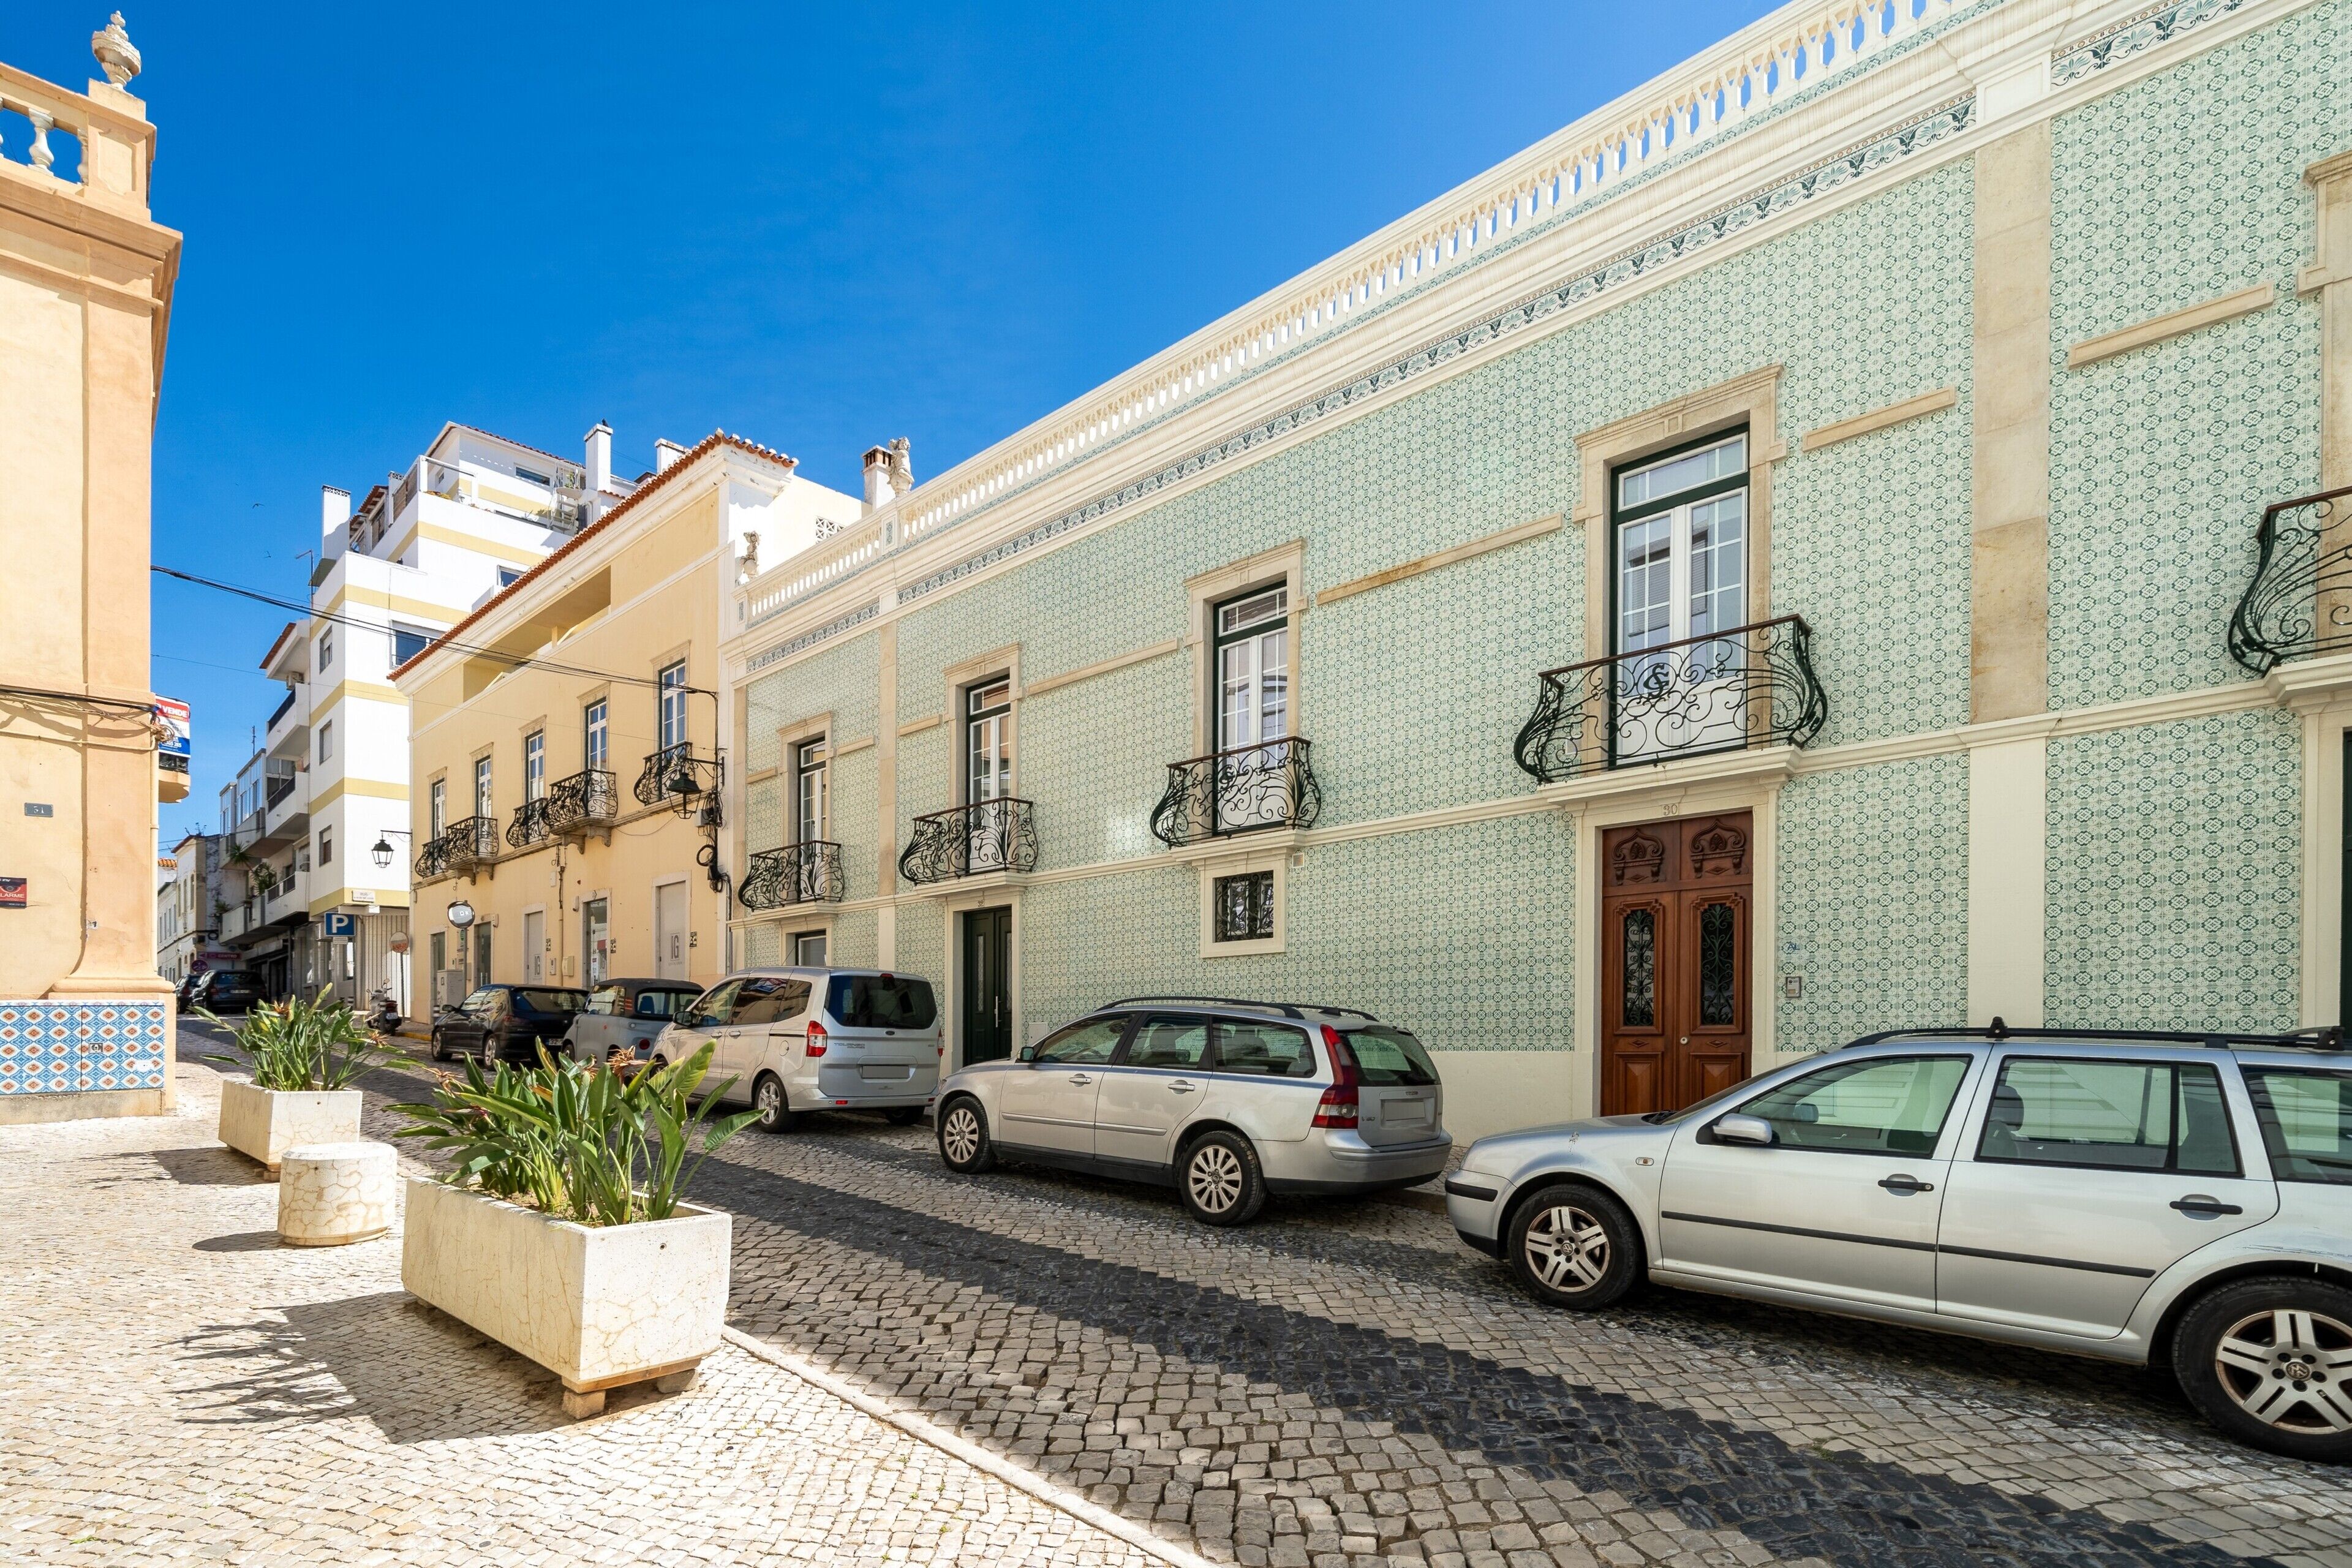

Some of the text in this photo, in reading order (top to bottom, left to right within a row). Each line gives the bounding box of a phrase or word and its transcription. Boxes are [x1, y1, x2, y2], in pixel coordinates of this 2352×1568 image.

[162, 705, 187, 718] VENDE
[1664, 804, 1678, 815] 30
[331, 914, 349, 933] P
[671, 935, 679, 959] IG
